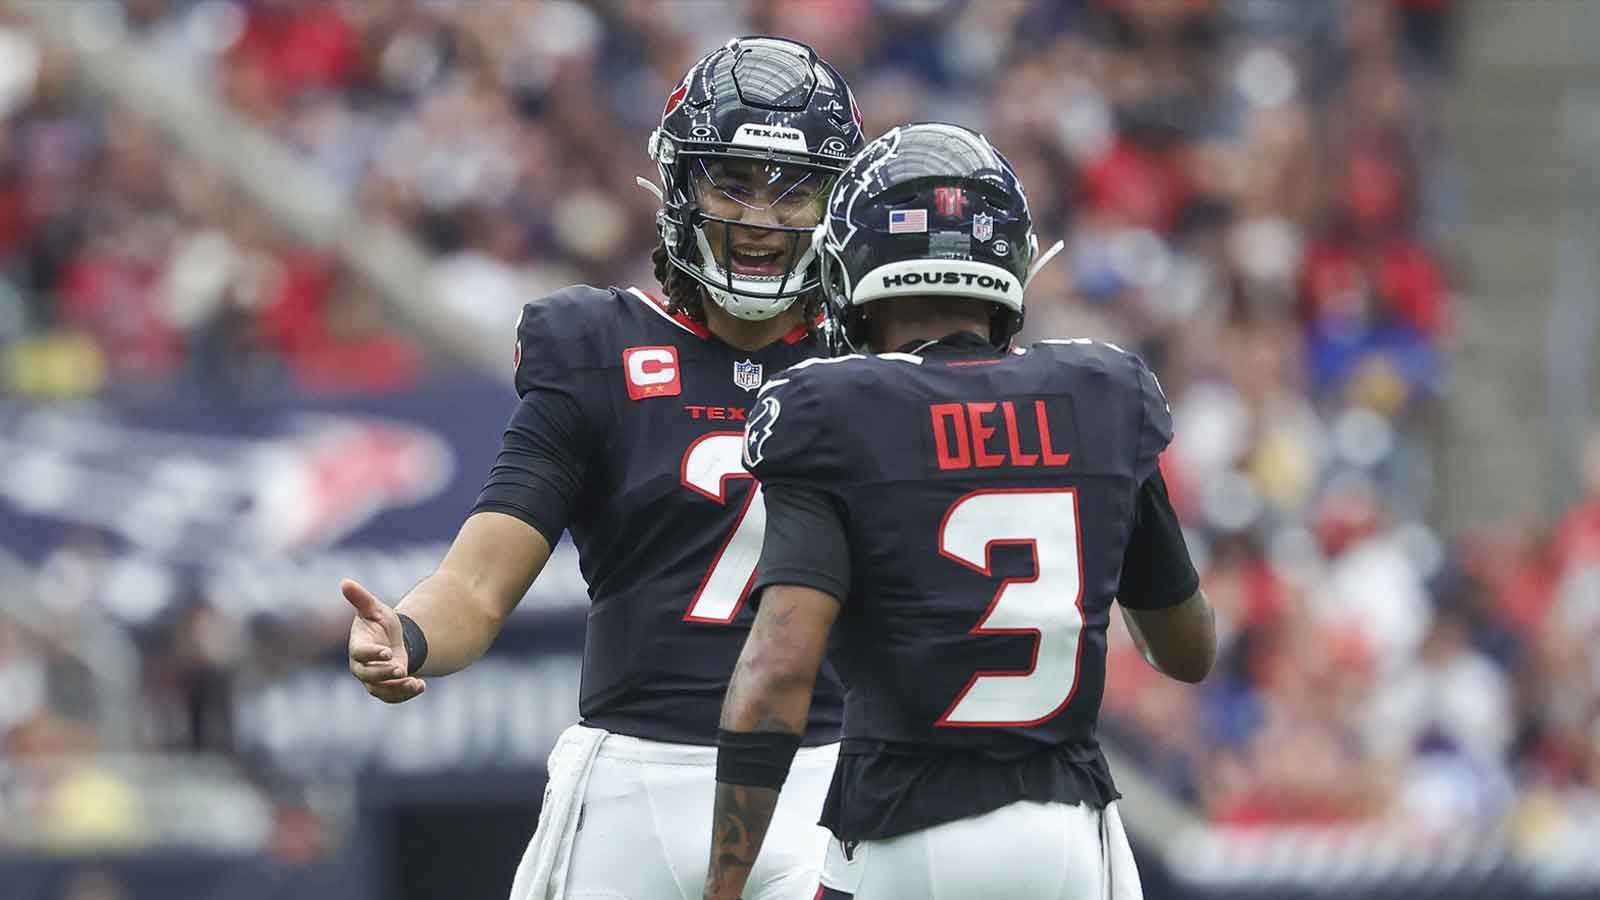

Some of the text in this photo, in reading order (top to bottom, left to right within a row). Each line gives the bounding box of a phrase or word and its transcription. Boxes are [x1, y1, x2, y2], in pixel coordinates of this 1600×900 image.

[744, 128, 800, 140] TEXANS
[883, 272, 1010, 293] HOUSTON
[628, 349, 676, 386] C
[736, 371, 761, 385] NFL
[684, 405, 746, 420] TEX
[929, 400, 1071, 470] DELL
[680, 430, 767, 624] 7
[934, 487, 1087, 728] 3
